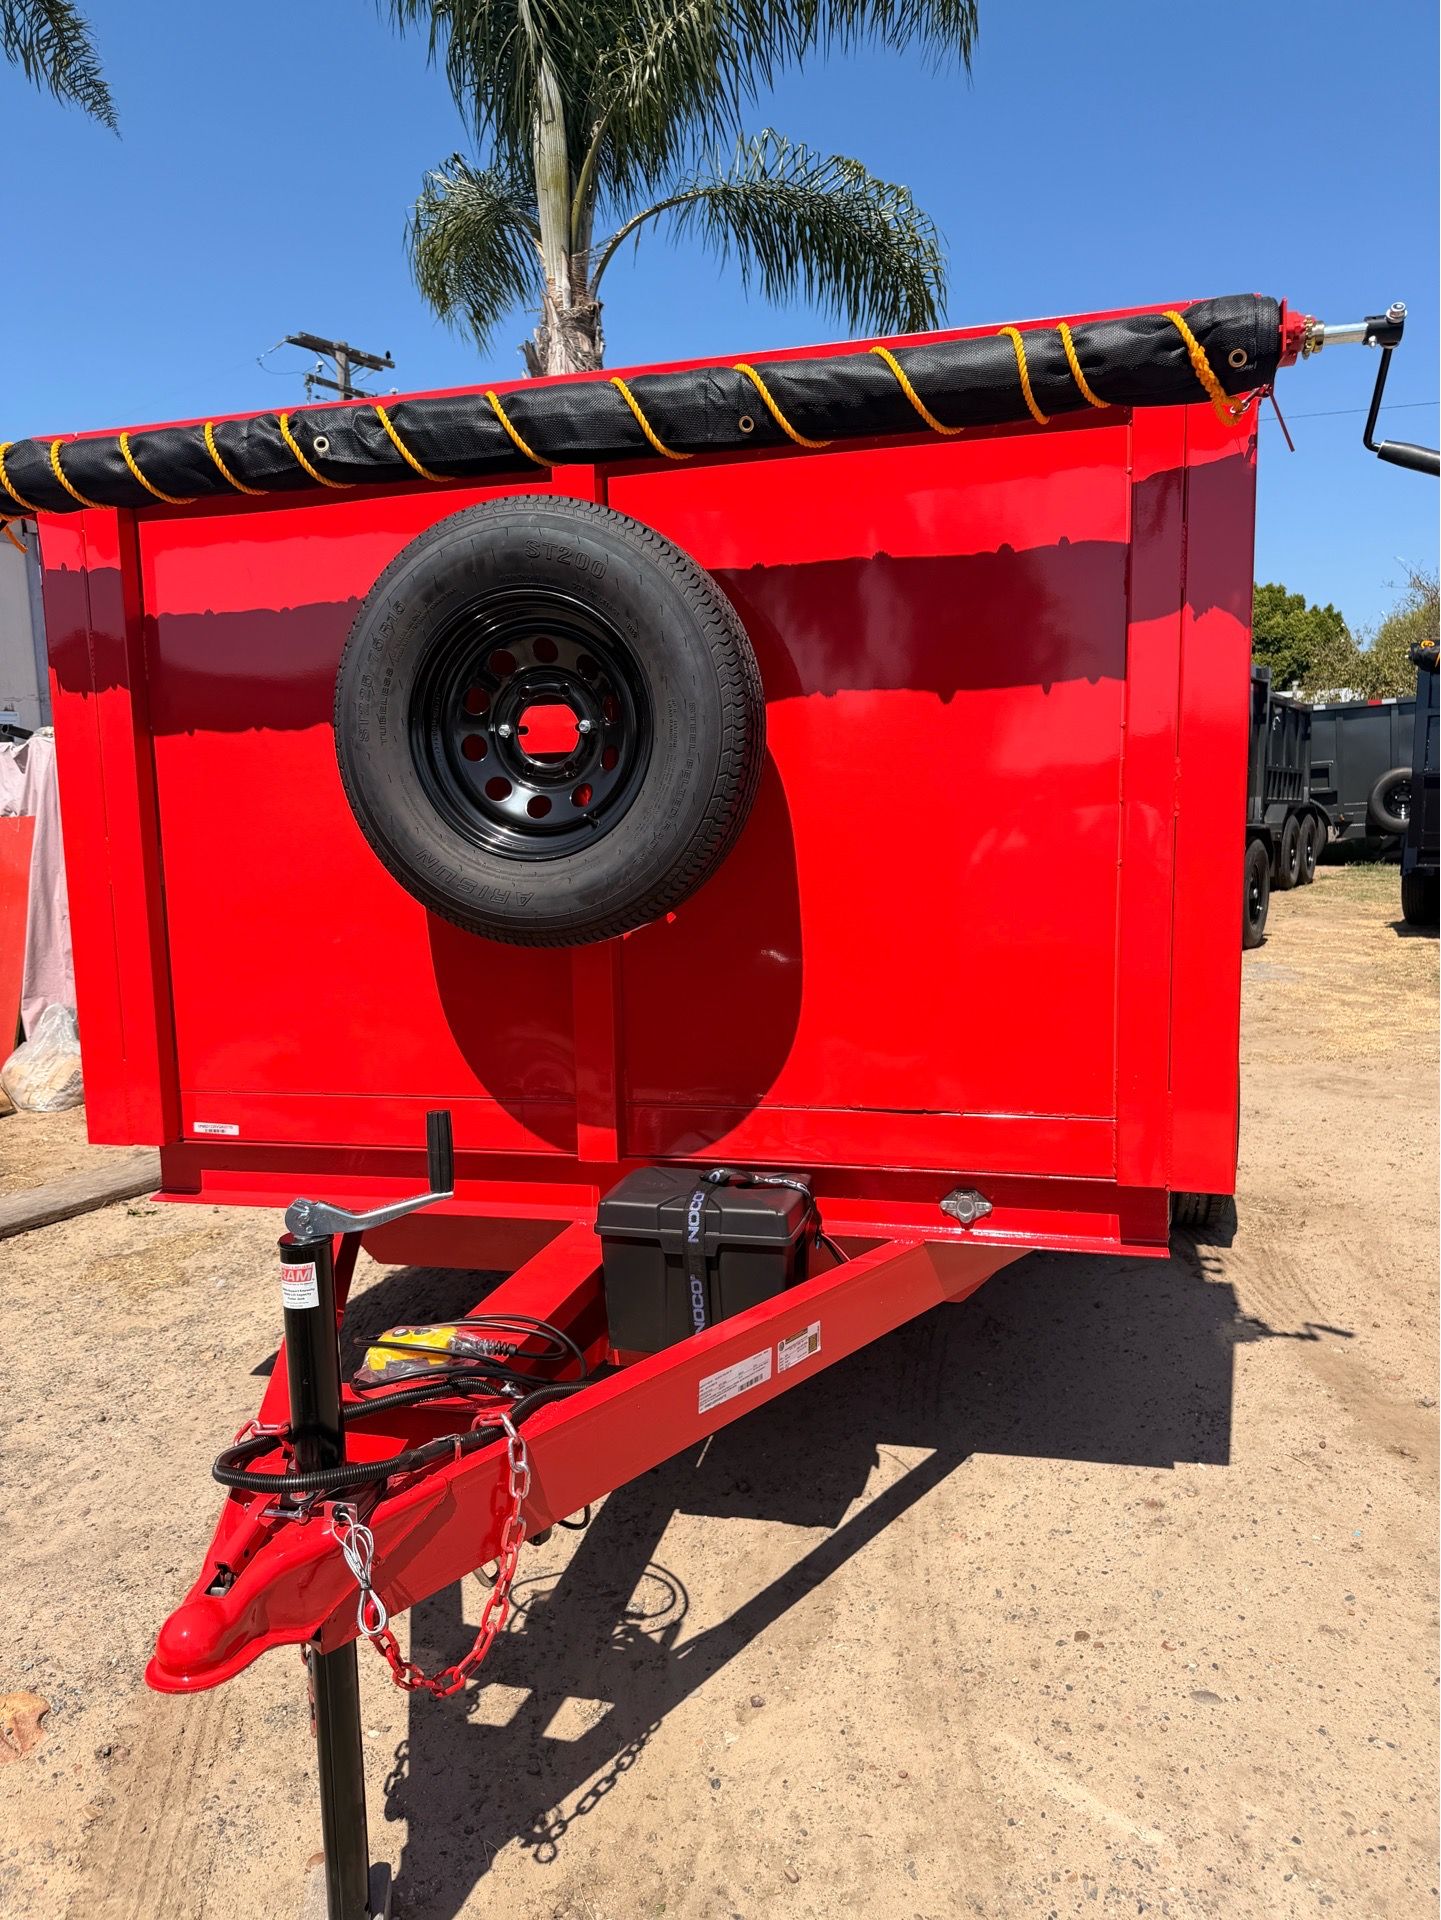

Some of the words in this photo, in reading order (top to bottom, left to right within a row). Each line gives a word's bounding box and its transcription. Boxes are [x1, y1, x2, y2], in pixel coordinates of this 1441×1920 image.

[524, 540, 607, 579] ST200
[378, 667, 394, 746] TUBELESS
[688, 702, 697, 752] STEEL
[671, 758, 694, 817] BELTED
[416, 849, 535, 906] ARISUN
[282, 1268, 312, 1282] RAM
